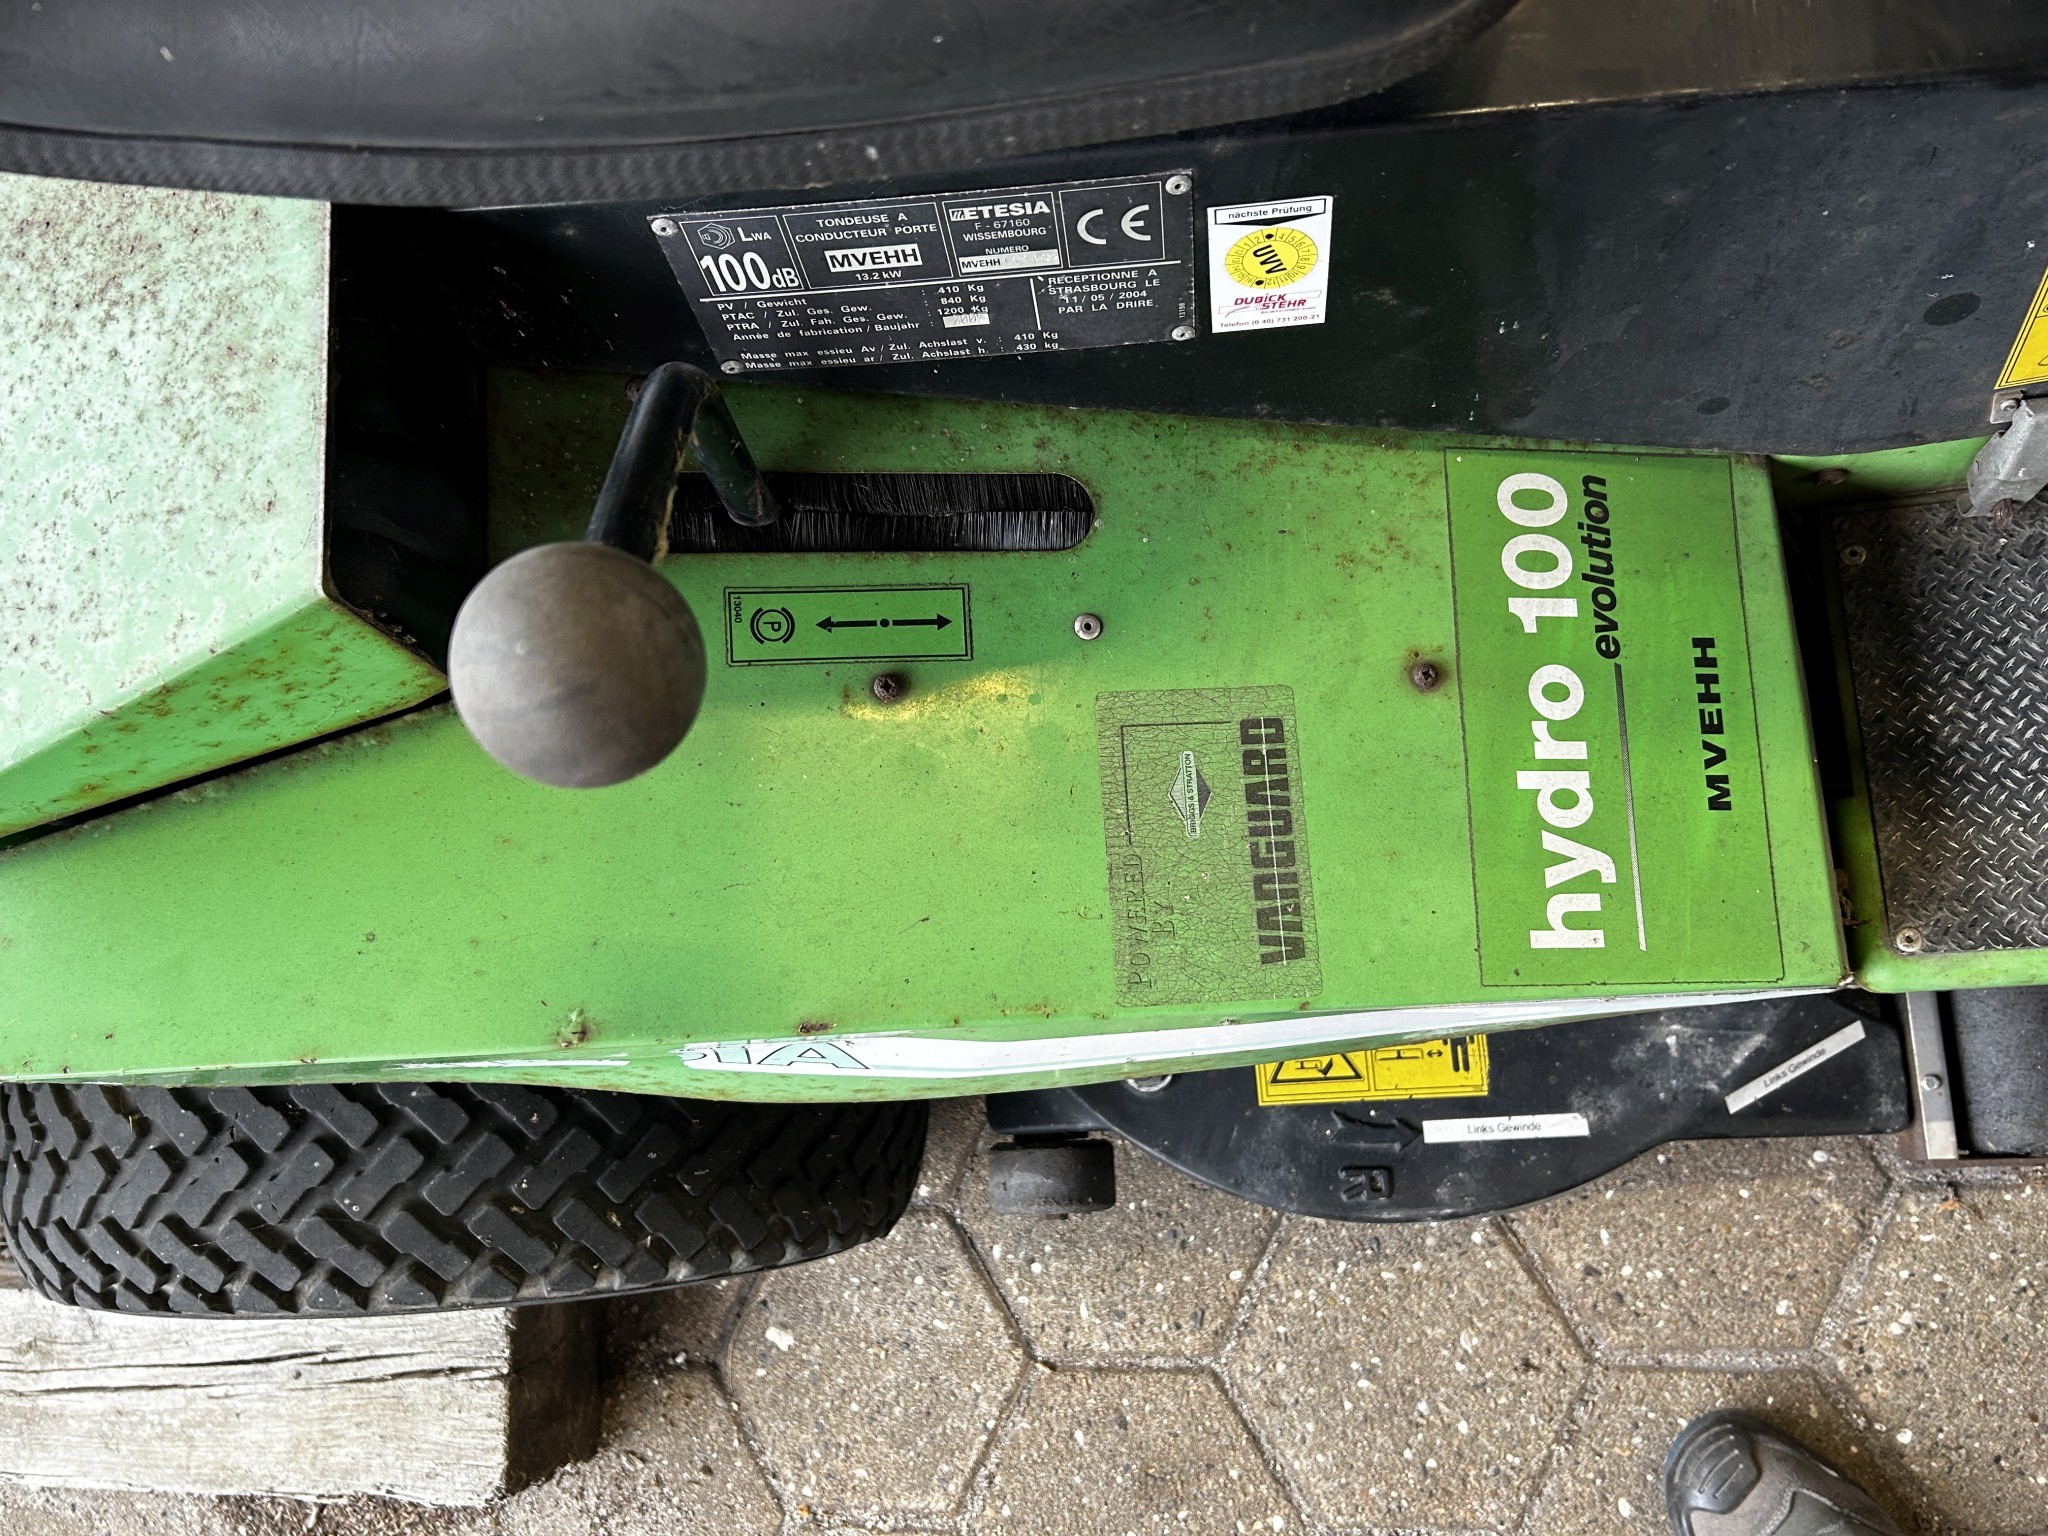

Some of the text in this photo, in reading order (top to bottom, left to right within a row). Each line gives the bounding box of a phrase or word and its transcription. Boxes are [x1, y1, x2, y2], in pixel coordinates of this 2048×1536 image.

[816, 213, 908, 228] TONDEUSE A
[964, 200, 1051, 220] ETESIA
[1228, 205, 1312, 219] nächste Prüfung
[796, 223, 938, 243] CONDUCTEUR PORTE
[963, 227, 1047, 242] WISSEMBOURG
[975, 222, 982, 230] F
[993, 218, 1030, 229] 67160
[1077, 204, 1152, 245] CE
[828, 248, 919, 269] MVEHH
[985, 245, 1029, 255] NUMERO
[1253, 244, 1288, 274] UVV
[961, 258, 1000, 269] MVEHH
[855, 270, 902, 281] 13.2 kW
[1048, 269, 1158, 285] RECEPTIONNE A
[717, 303, 733, 311] PV
[756, 298, 808, 309] Gewicht
[938, 285, 960, 294] 410
[967, 284, 985, 293] Kg
[1048, 279, 1161, 295] STRASBOURG LE
[1091, 293, 1105, 301] 05
[1118, 290, 1148, 300] 2004
[721, 312, 755, 321] PTAC
[776, 310, 800, 318] Zul.
[806, 307, 834, 315] Ges.
[840, 305, 872, 313] Gew.
[940, 296, 962, 305] 840
[969, 295, 987, 304] Kg
[1058, 299, 1154, 314] PAR LA DRIRE
[1262, 300, 1307, 310] STEHR
[726, 322, 760, 331] PTRA
[780, 320, 804, 328] Zul.
[810, 318, 835, 326] Fah.
[842, 315, 870, 324] Ges.
[876, 313, 908, 321] Gew.
[937, 307, 965, 316] 1200
[972, 305, 989, 314] Kg
[799, 326, 863, 337] fabrication
[875, 321, 920, 332] Baujahr
[740, 351, 778, 360] Masse
[817, 347, 853, 356] essieu
[861, 345, 876, 353] Av
[889, 342, 911, 351] Zul.
[918, 338, 968, 349] Achslast
[1014, 333, 1035, 341] 410
[1042, 332, 1059, 340] Kg
[745, 361, 782, 369] Masse
[789, 359, 813, 367] max
[821, 357, 857, 365] essieu
[863, 355, 875, 363] ar
[892, 353, 914, 361] Zul.
[922, 348, 971, 359] Achslast
[1016, 343, 1037, 351] 430
[1045, 342, 1059, 350] kg
[1581, 475, 1621, 660] evolution
[733, 595, 743, 624] 13040
[1496, 472, 1617, 949] hydro 100
[1691, 637, 1732, 811] MVEHH
[1184, 753, 1194, 794] STRATTON
[1187, 804, 1198, 835] BRIGGS
[1239, 717, 1306, 965] VANGUARD
[1124, 854, 1152, 988] POWERED
[1763, 1048, 1826, 1088] Links Gewinde
[1468, 1121, 1541, 1134] Links Gewinde
